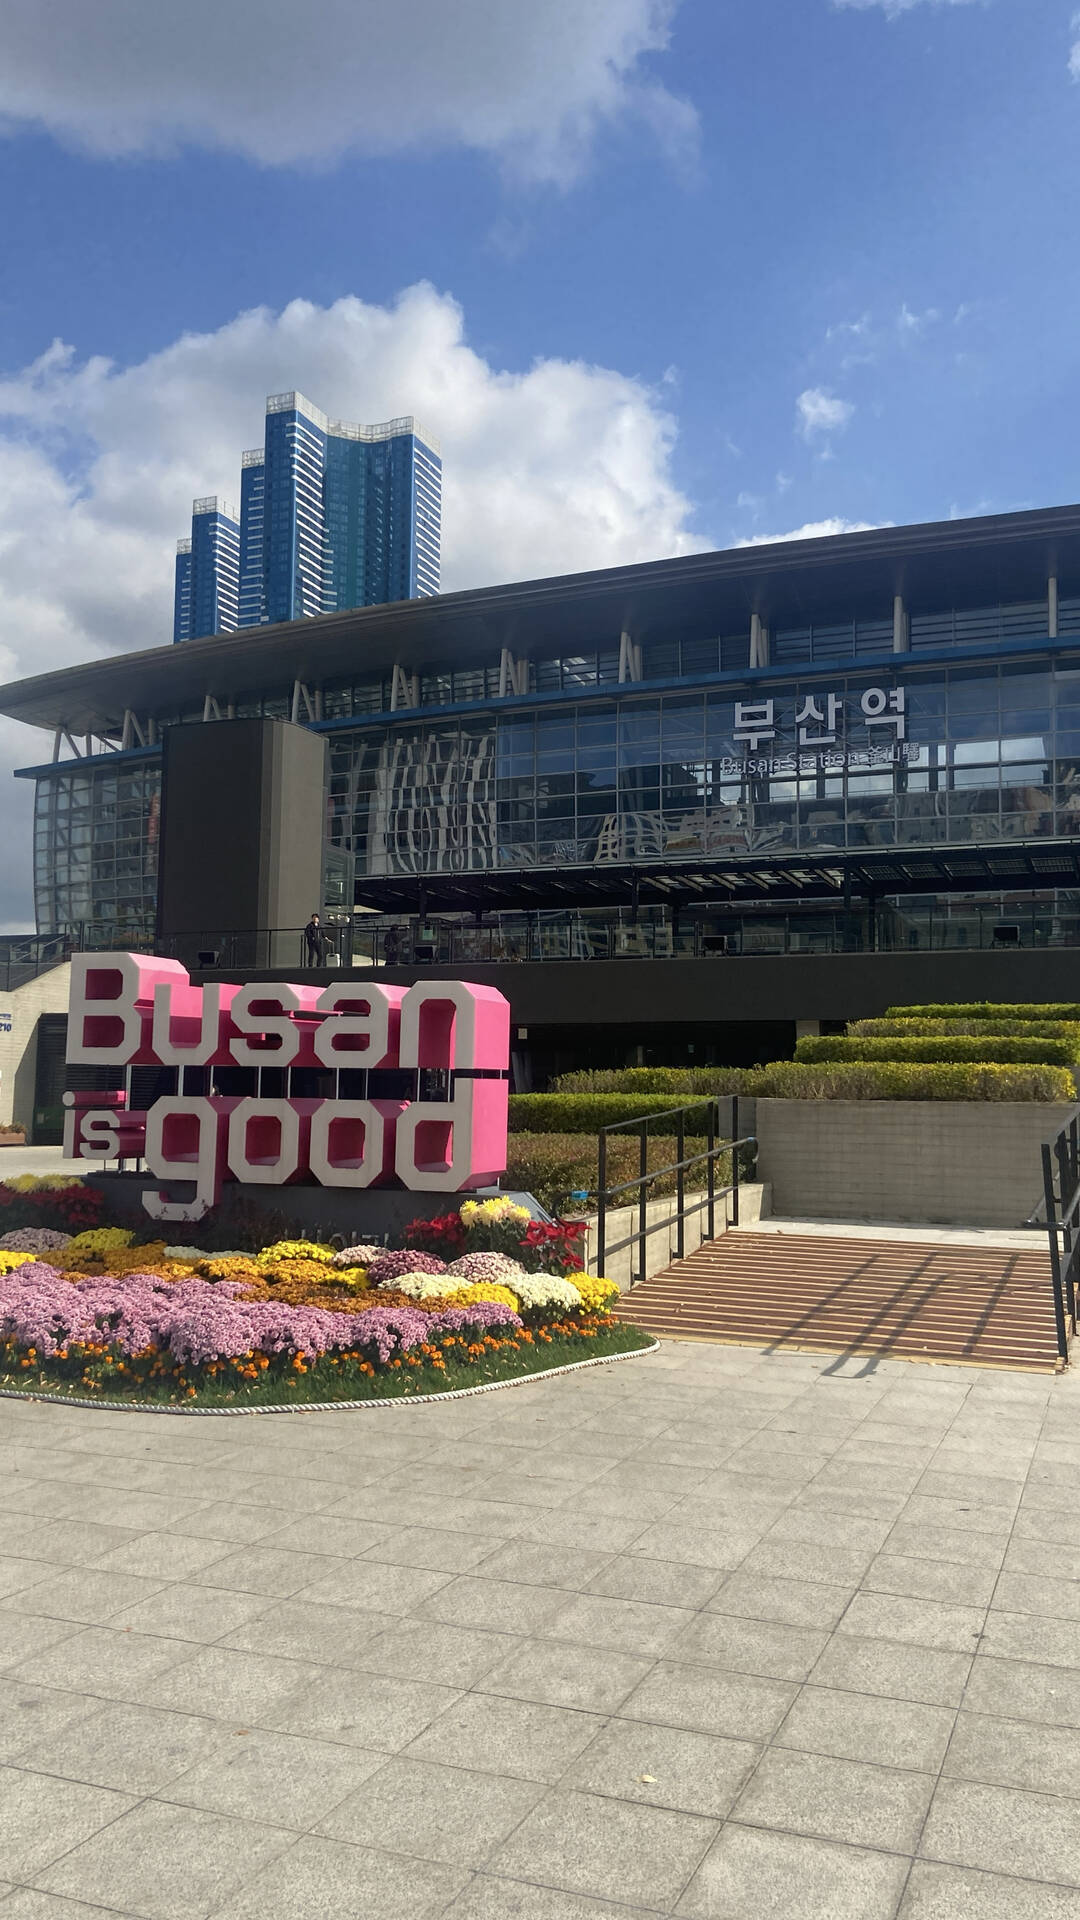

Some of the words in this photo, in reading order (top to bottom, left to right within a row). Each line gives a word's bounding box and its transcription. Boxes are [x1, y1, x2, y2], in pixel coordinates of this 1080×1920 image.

[721, 756, 780, 775] Busan
[786, 749, 858, 771] Station
[733, 687, 905, 750] 부산역
[65, 952, 478, 1069] Busan
[62, 1090, 121, 1159] is
[141, 1077, 476, 1222] good
